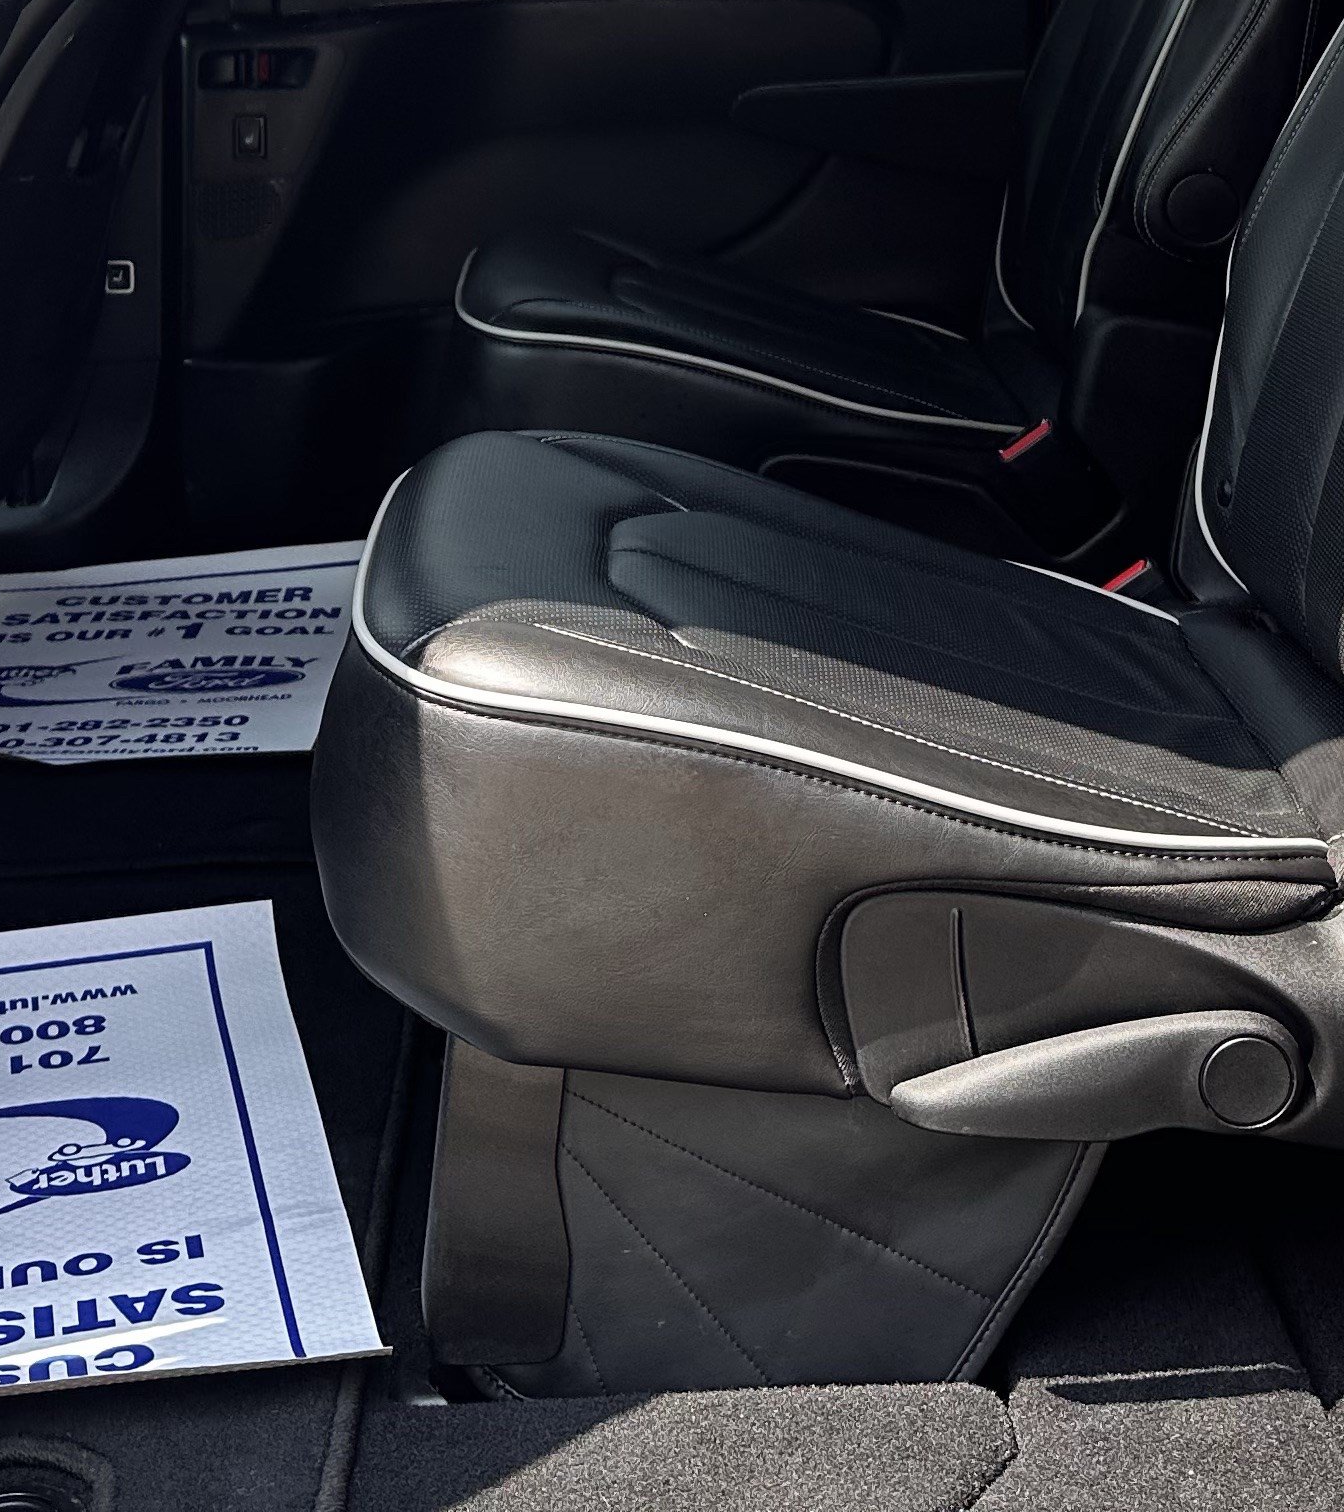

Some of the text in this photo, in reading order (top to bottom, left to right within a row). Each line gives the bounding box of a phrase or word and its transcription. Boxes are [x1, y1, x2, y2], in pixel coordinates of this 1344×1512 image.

[55, 586, 314, 607] CUSTOMER
[0, 607, 343, 626] SATISFACTION
[45, 628, 133, 644] OUR
[224, 625, 335, 637] GOAL
[115, 655, 320, 676] FAMILY
[115, 693, 293, 707] FARGO MOORHEAD
[31, 1154, 168, 1190] Luther
[136, 1234, 205, 1266] IS
